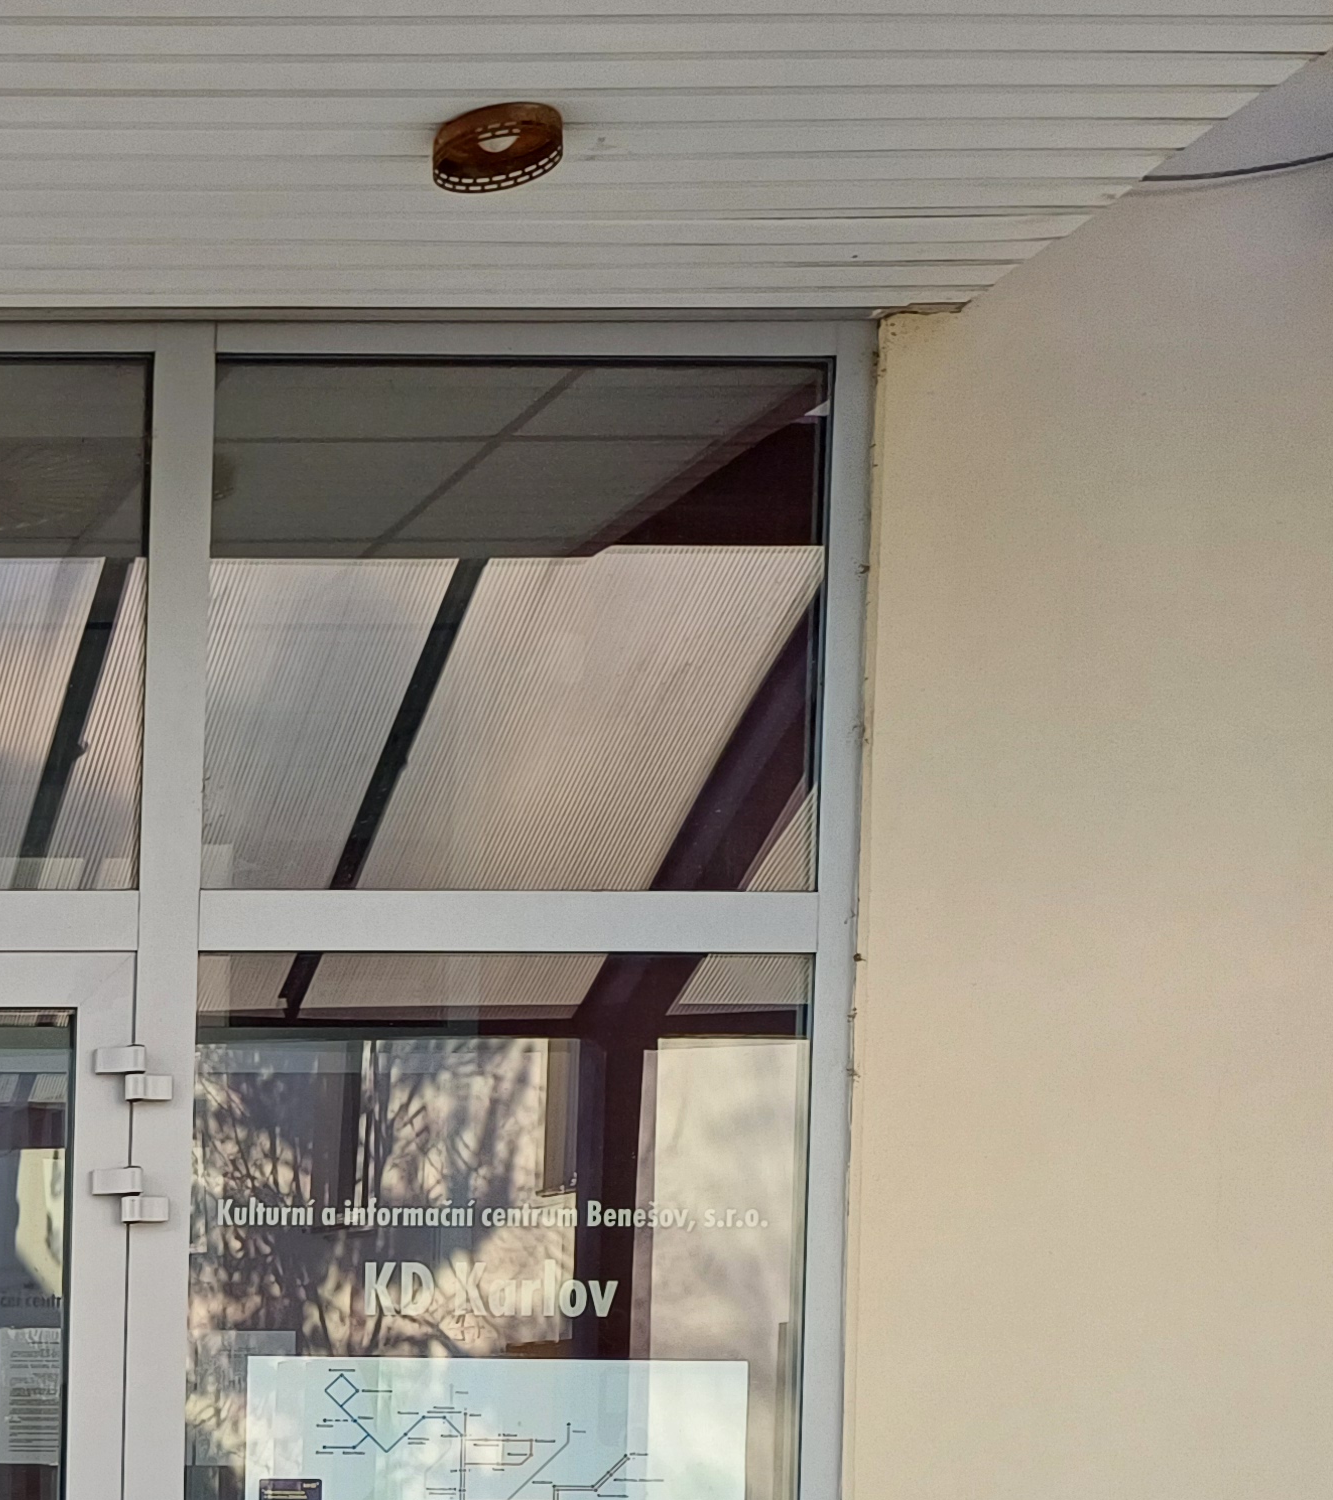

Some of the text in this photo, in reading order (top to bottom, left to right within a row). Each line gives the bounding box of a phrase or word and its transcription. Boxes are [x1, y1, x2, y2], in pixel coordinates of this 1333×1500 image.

[217, 1200, 768, 1232] Kulturní a informační centrum Benešov, s.r.o.
[365, 1262, 618, 1318] KD Karlov
